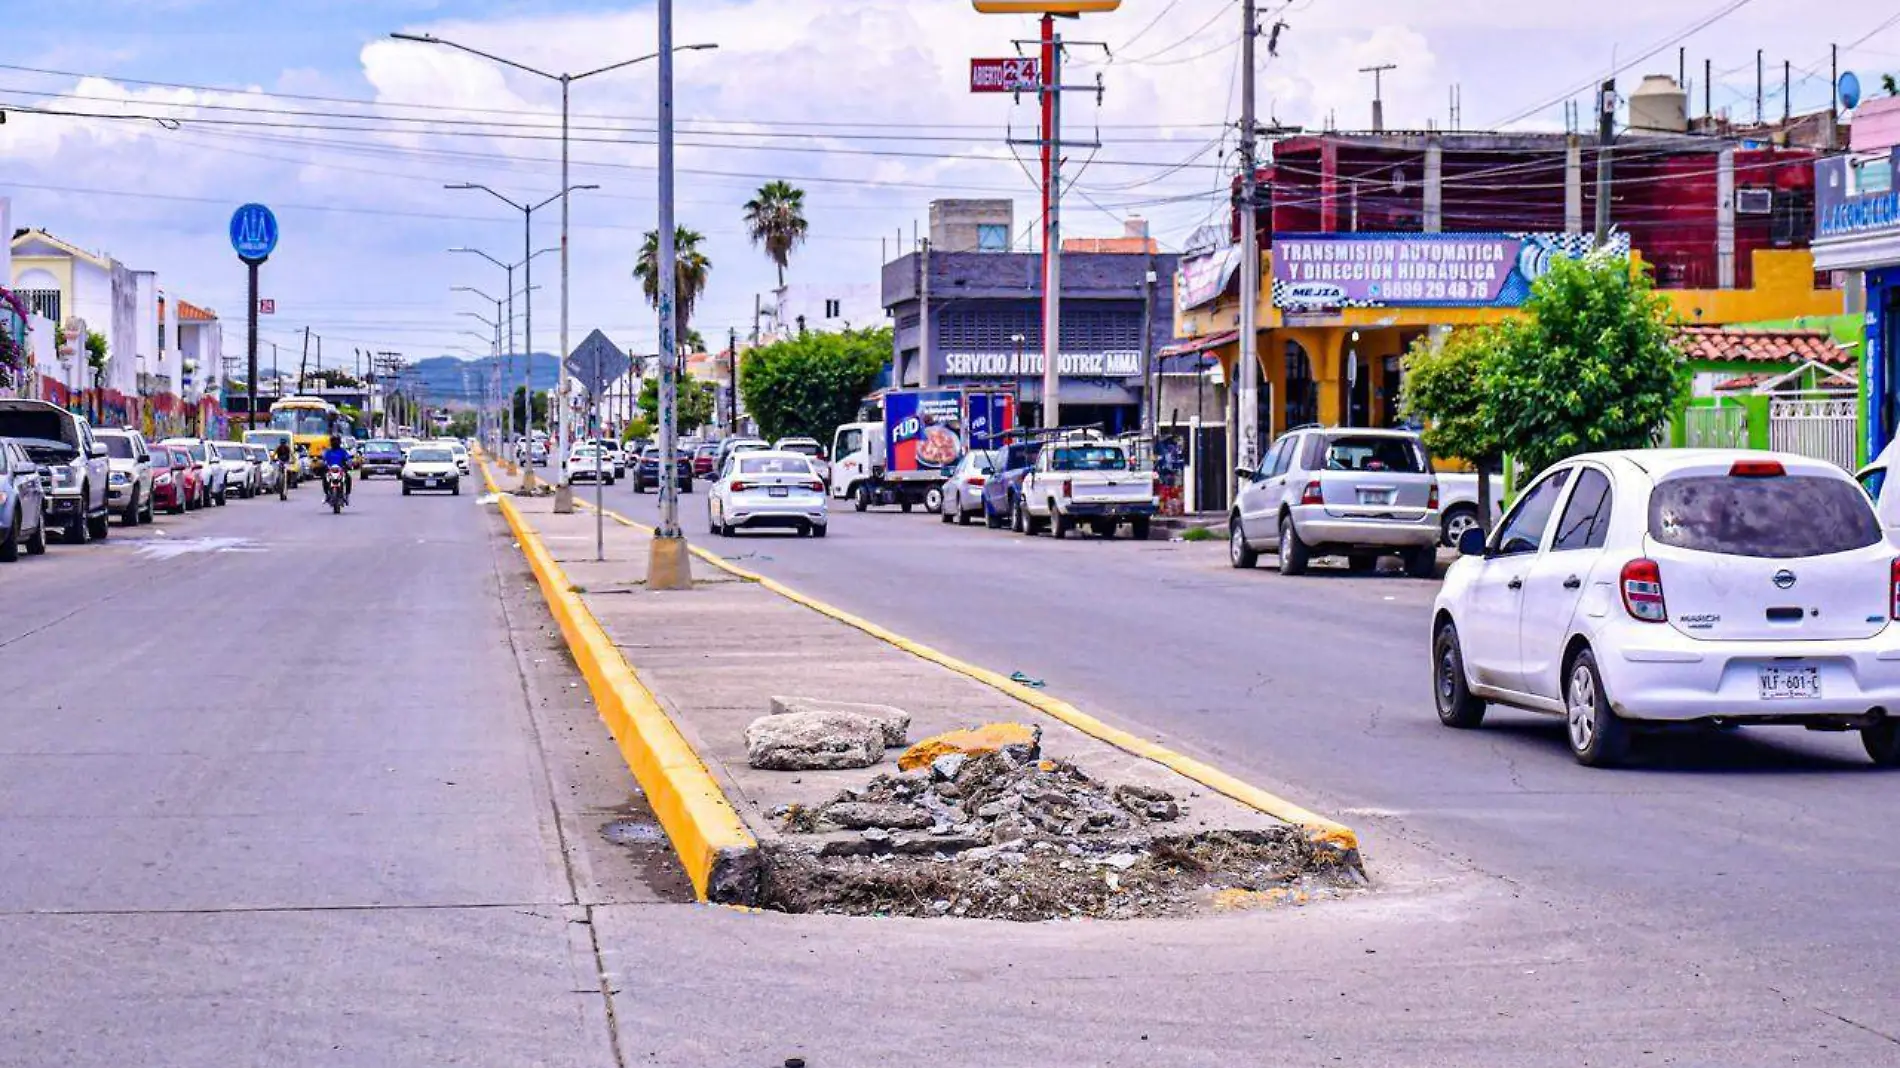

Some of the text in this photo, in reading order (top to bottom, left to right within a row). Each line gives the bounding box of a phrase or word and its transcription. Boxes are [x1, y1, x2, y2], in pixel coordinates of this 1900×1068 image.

[1289, 263, 1299, 280] Y
[1292, 288, 1340, 296] MEJIA
[945, 352, 1138, 374] SERVICIO AUTOOTRIZ MMA
[892, 418, 919, 442] FUD
[1760, 676, 1819, 689] VLF-601-C
